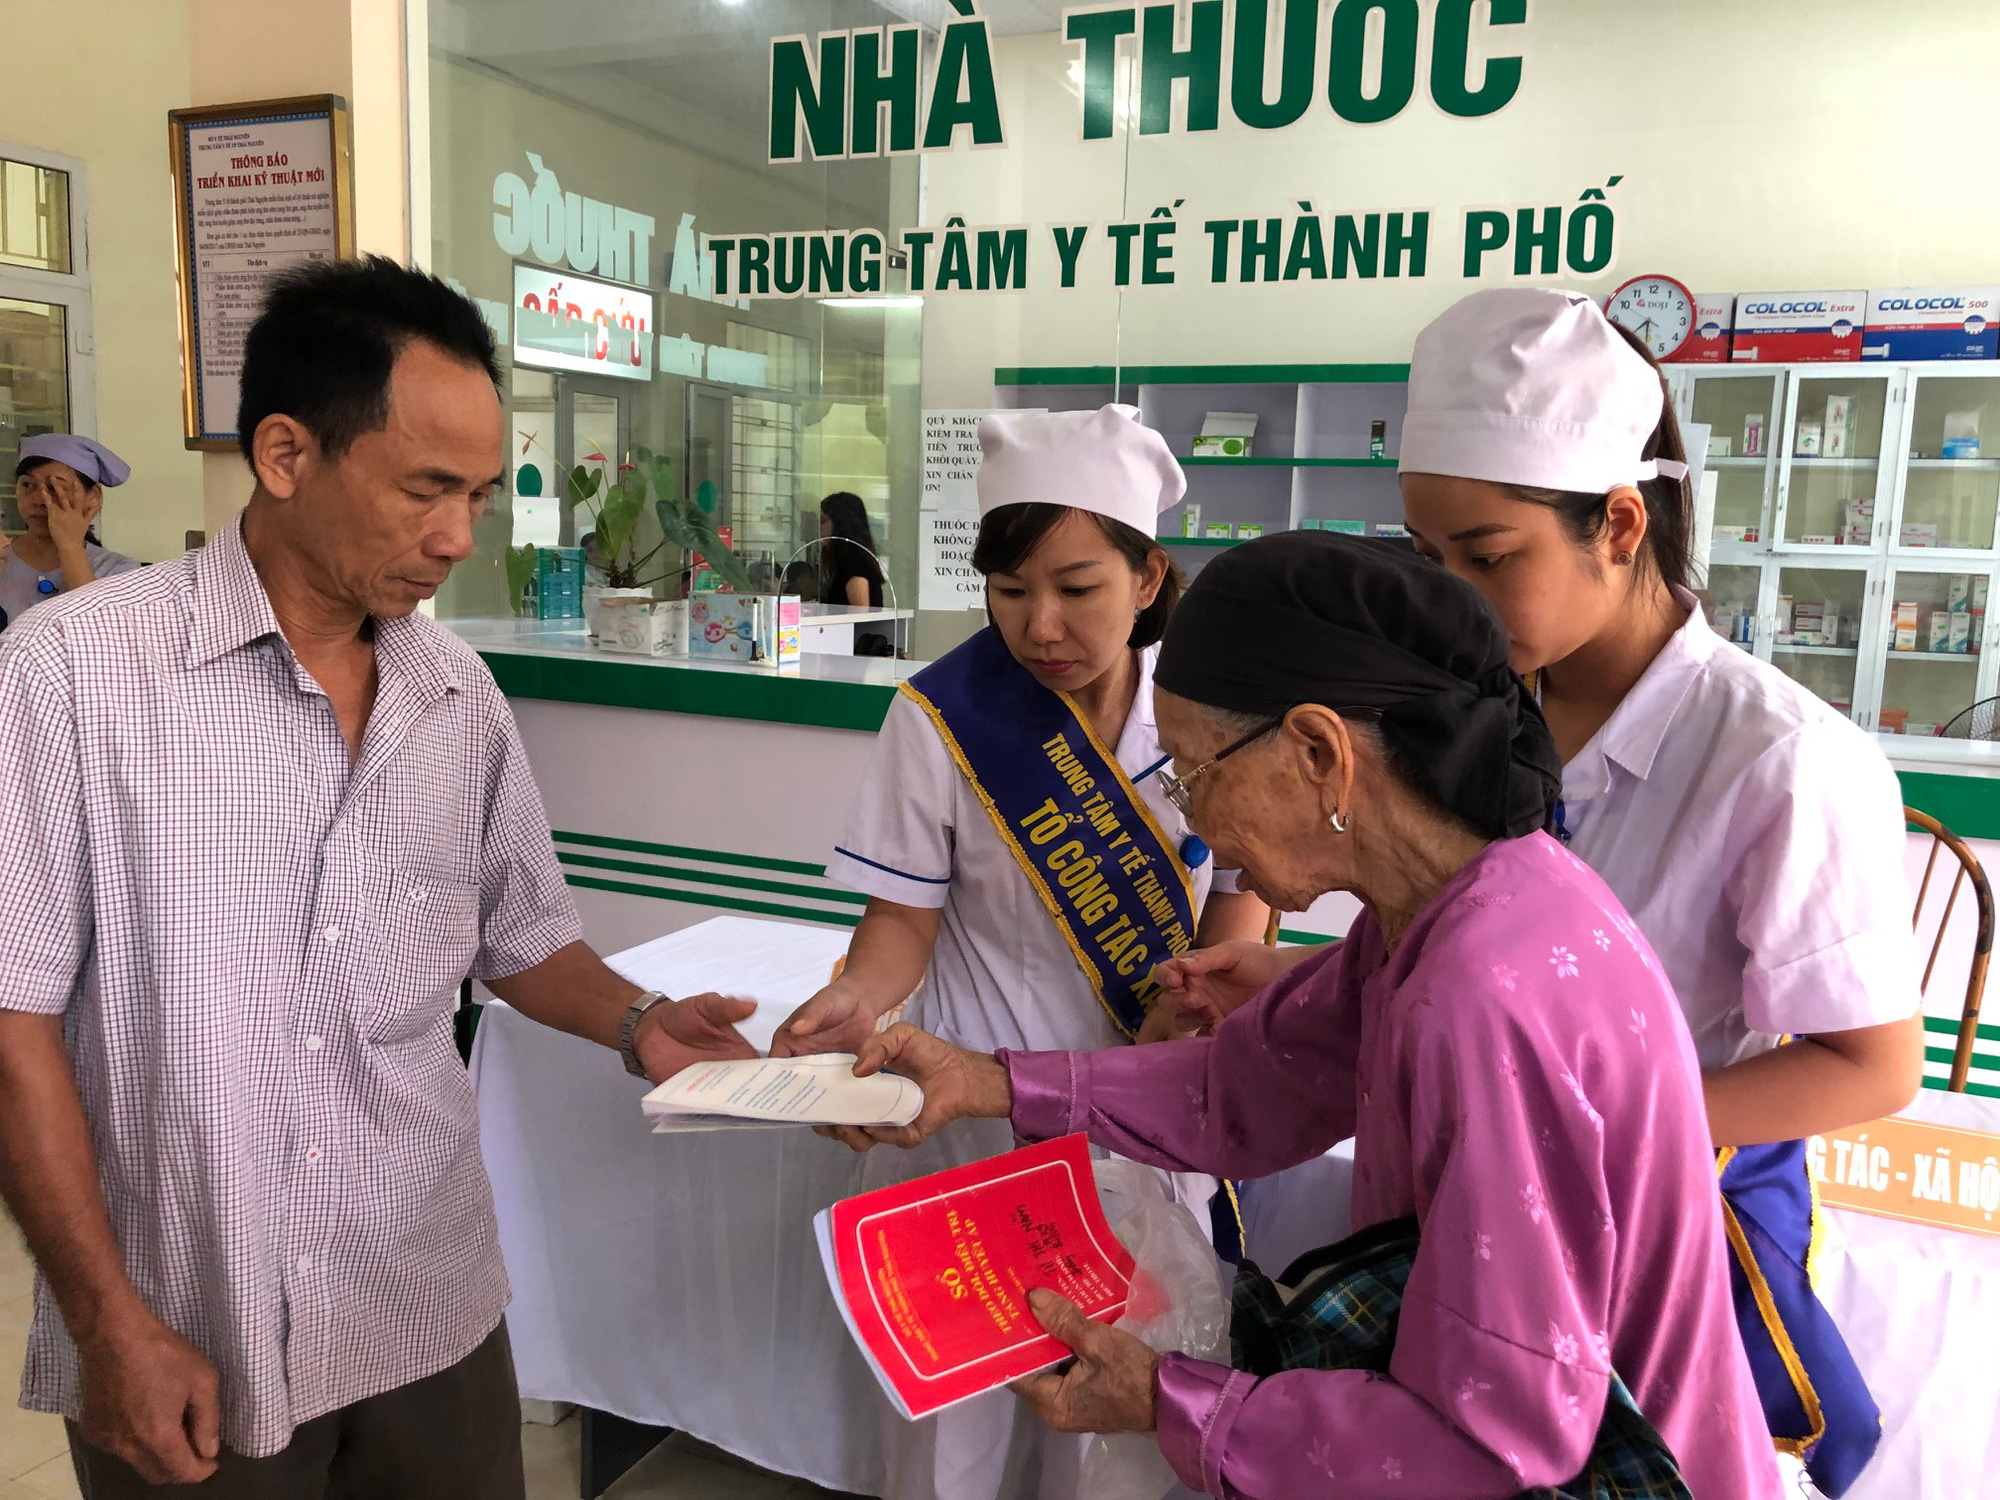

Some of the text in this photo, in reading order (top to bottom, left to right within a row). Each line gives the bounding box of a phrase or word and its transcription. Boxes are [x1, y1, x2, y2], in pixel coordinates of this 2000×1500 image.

[770, 0, 1004, 160] NHÀ
[231, 151, 288, 170] THÔNG BÁO
[197, 171, 225, 189] TRIỂN
[228, 173, 252, 188] KHAI
[271, 169, 303, 186] THUẬT
[306, 167, 325, 183] MỚI
[709, 233, 882, 295] TRUNG
[904, 216, 1027, 290] TÂM
[1053, 226, 1088, 288] Y
[1107, 199, 1185, 286] TẾ
[1205, 201, 1430, 283] THÀNH
[1463, 175, 1624, 278] PHỐ
[1633, 289, 1642, 298] 11
[1648, 285, 1659, 294] 12
[1667, 290, 1672, 299] 1
[1620, 300, 1630, 309] 10
[1648, 301, 1668, 311] DOJI
[1676, 301, 1684, 310] 2
[1745, 301, 1855, 315] COLOCOL Extra
[1878, 297, 1988, 311] COLOCOL 500
[1699, 308, 1723, 316] Extra
[1679, 317, 1686, 326] 3
[1672, 333, 1679, 341] 4
[1658, 343, 1665, 352] 5
[926, 415, 982, 426] QUÝ KHÁC
[954, 430, 973, 438] TRA
[926, 469, 973, 480] XIN CHÂN
[933, 534, 972, 545] KHÔNG
[934, 567, 953, 576] XIN
[1042, 732, 1095, 797] TRUNG
[1081, 791, 1116, 837] TÂM
[1020, 797, 1085, 846] TỔ
[1108, 831, 1132, 850] Y
[1118, 846, 1156, 876] TẾ
[1046, 839, 1119, 928] CÔNG
[1133, 871, 1176, 927] THÀNH
[1094, 914, 1149, 976] TÁC
[1833, 1133, 1890, 1192] TÁC
[1912, 1147, 1952, 1204] XÃ
[1958, 1156, 2000, 1221] HỘ
